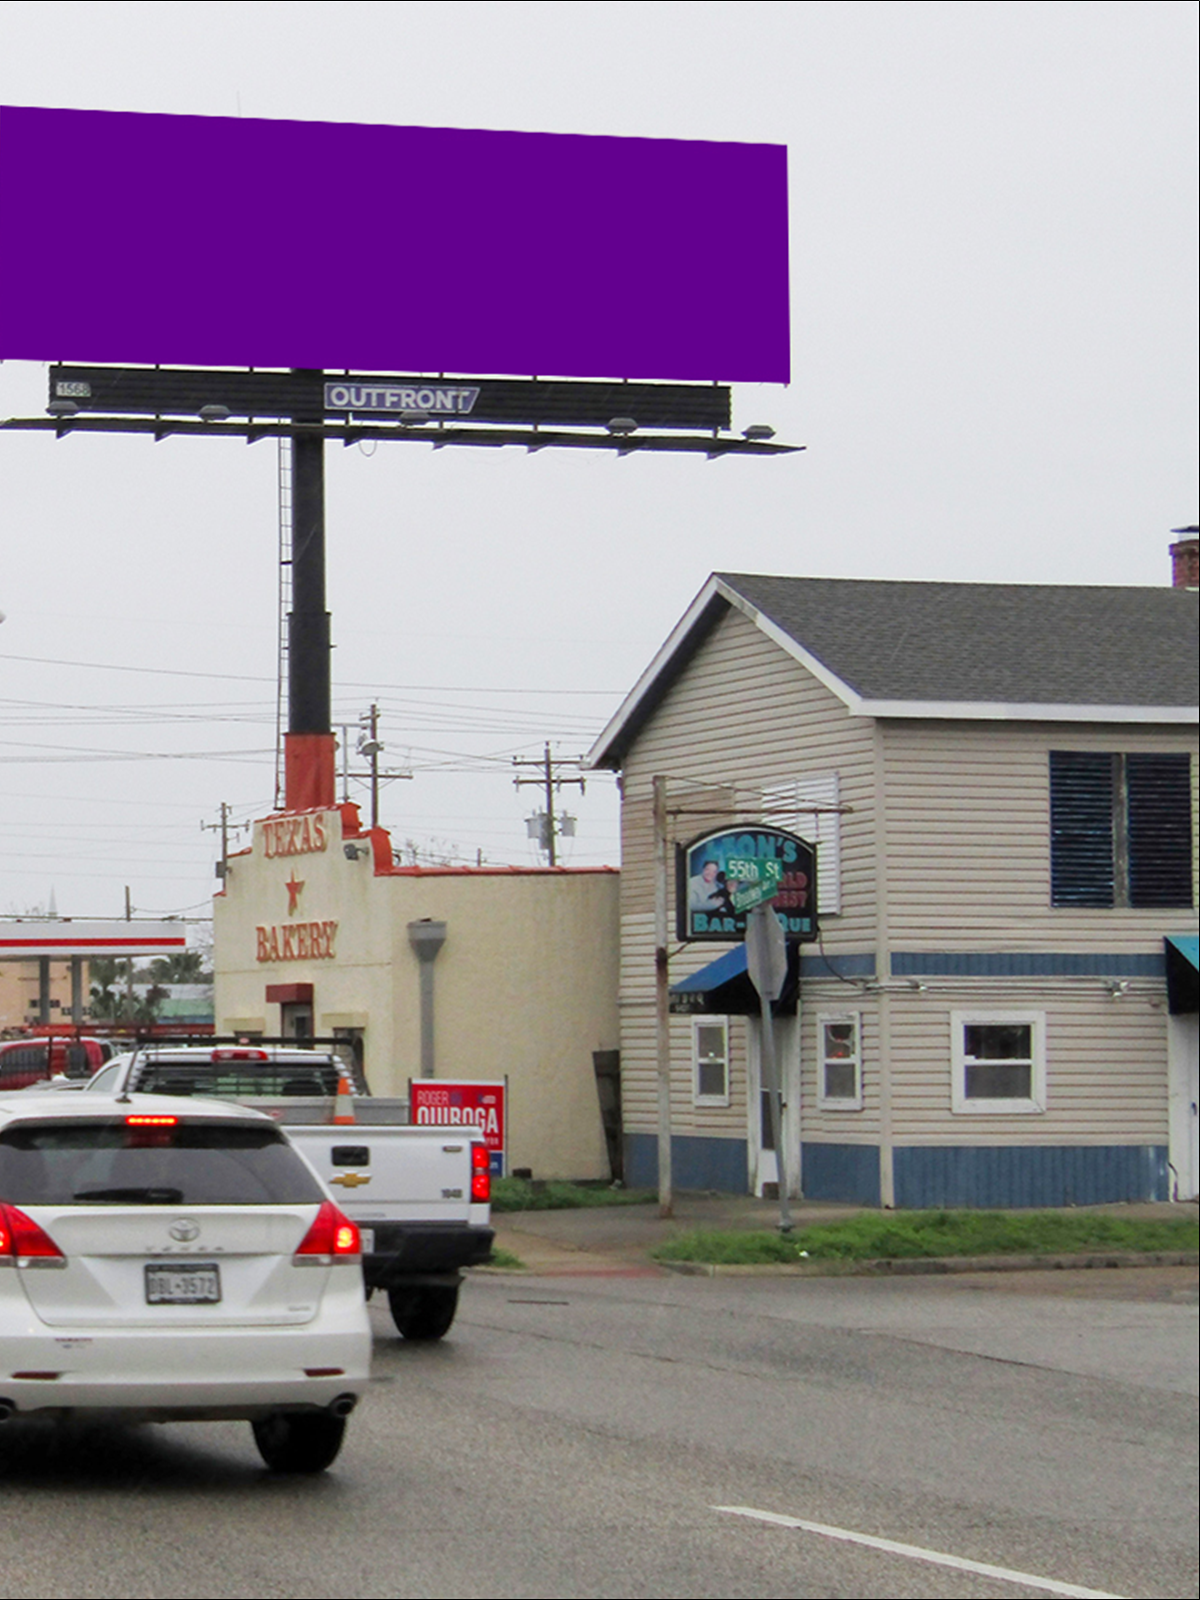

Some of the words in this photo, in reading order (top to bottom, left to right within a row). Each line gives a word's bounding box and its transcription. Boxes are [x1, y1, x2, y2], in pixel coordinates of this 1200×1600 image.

[330, 386, 470, 410] OUTFRONT
[263, 813, 327, 859] TEXAS
[728, 860, 758, 879] 55th
[765, 861, 780, 880] St
[255, 920, 338, 963] BAKERY
[417, 1090, 449, 1105] ROGER
